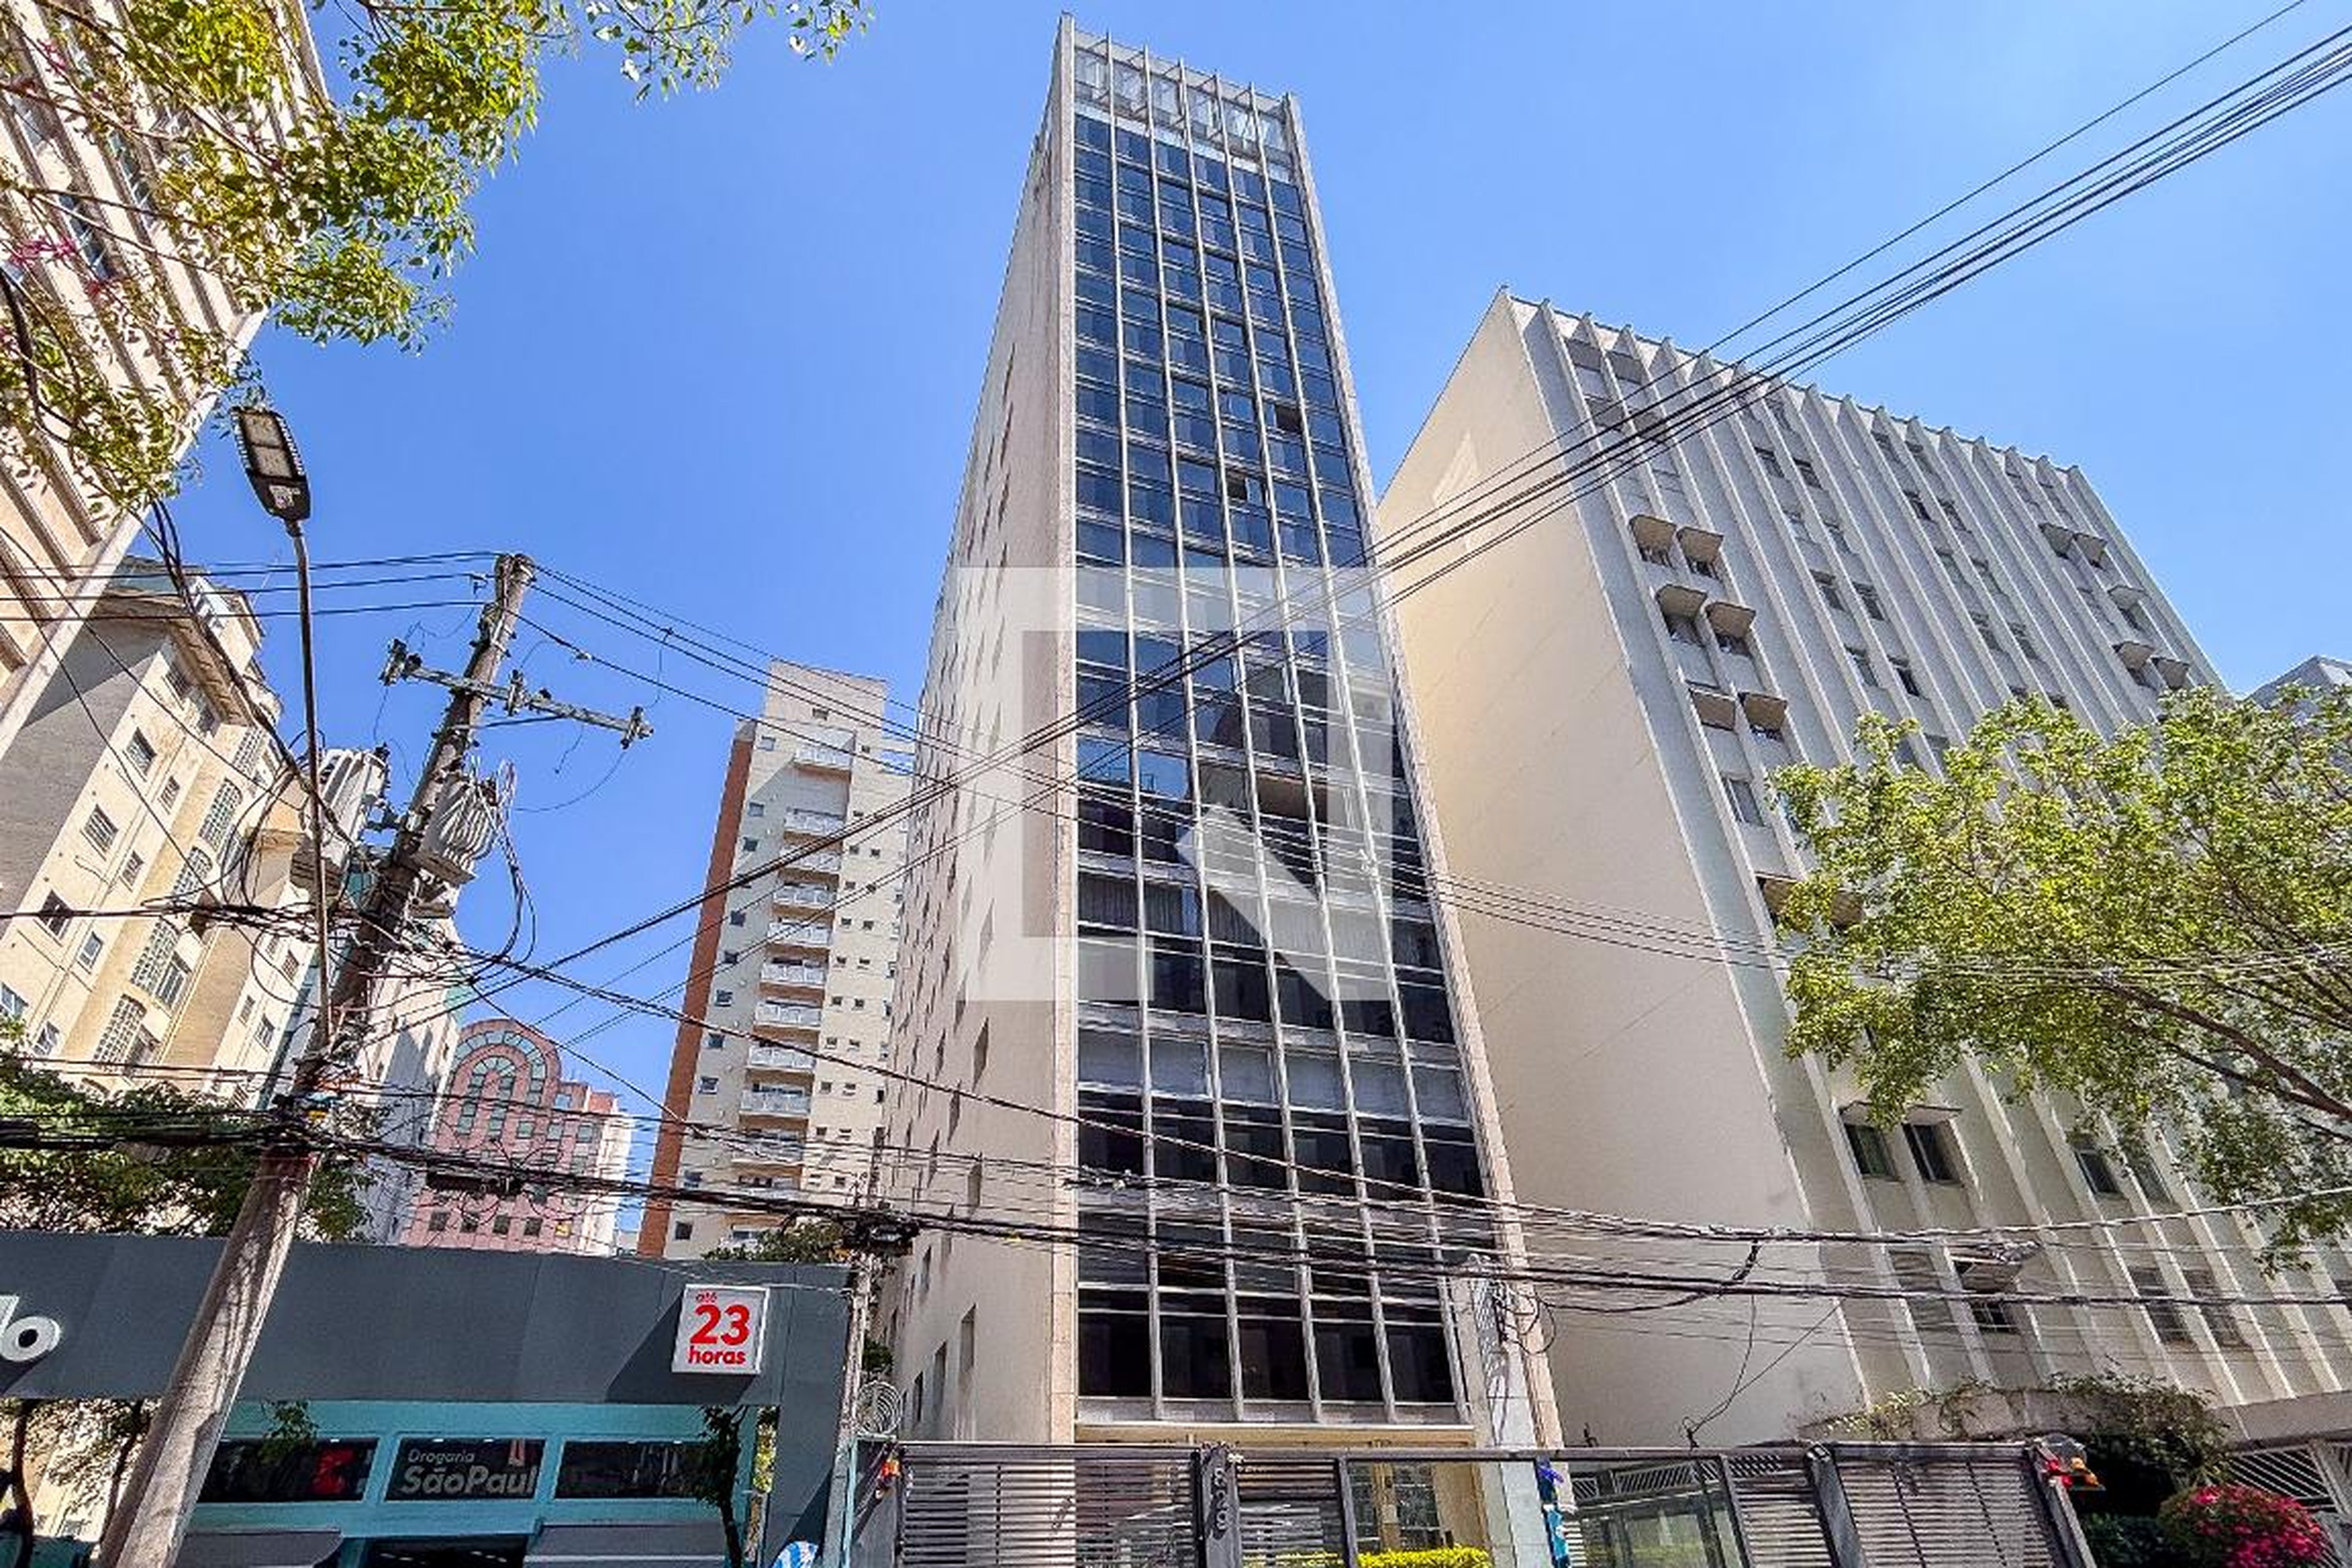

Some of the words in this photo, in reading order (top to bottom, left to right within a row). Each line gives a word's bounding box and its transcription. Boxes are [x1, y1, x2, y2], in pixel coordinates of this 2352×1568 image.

[690, 1305, 750, 1346] 23
[688, 1345, 746, 1364] horas
[408, 1448, 475, 1464] Drogaria
